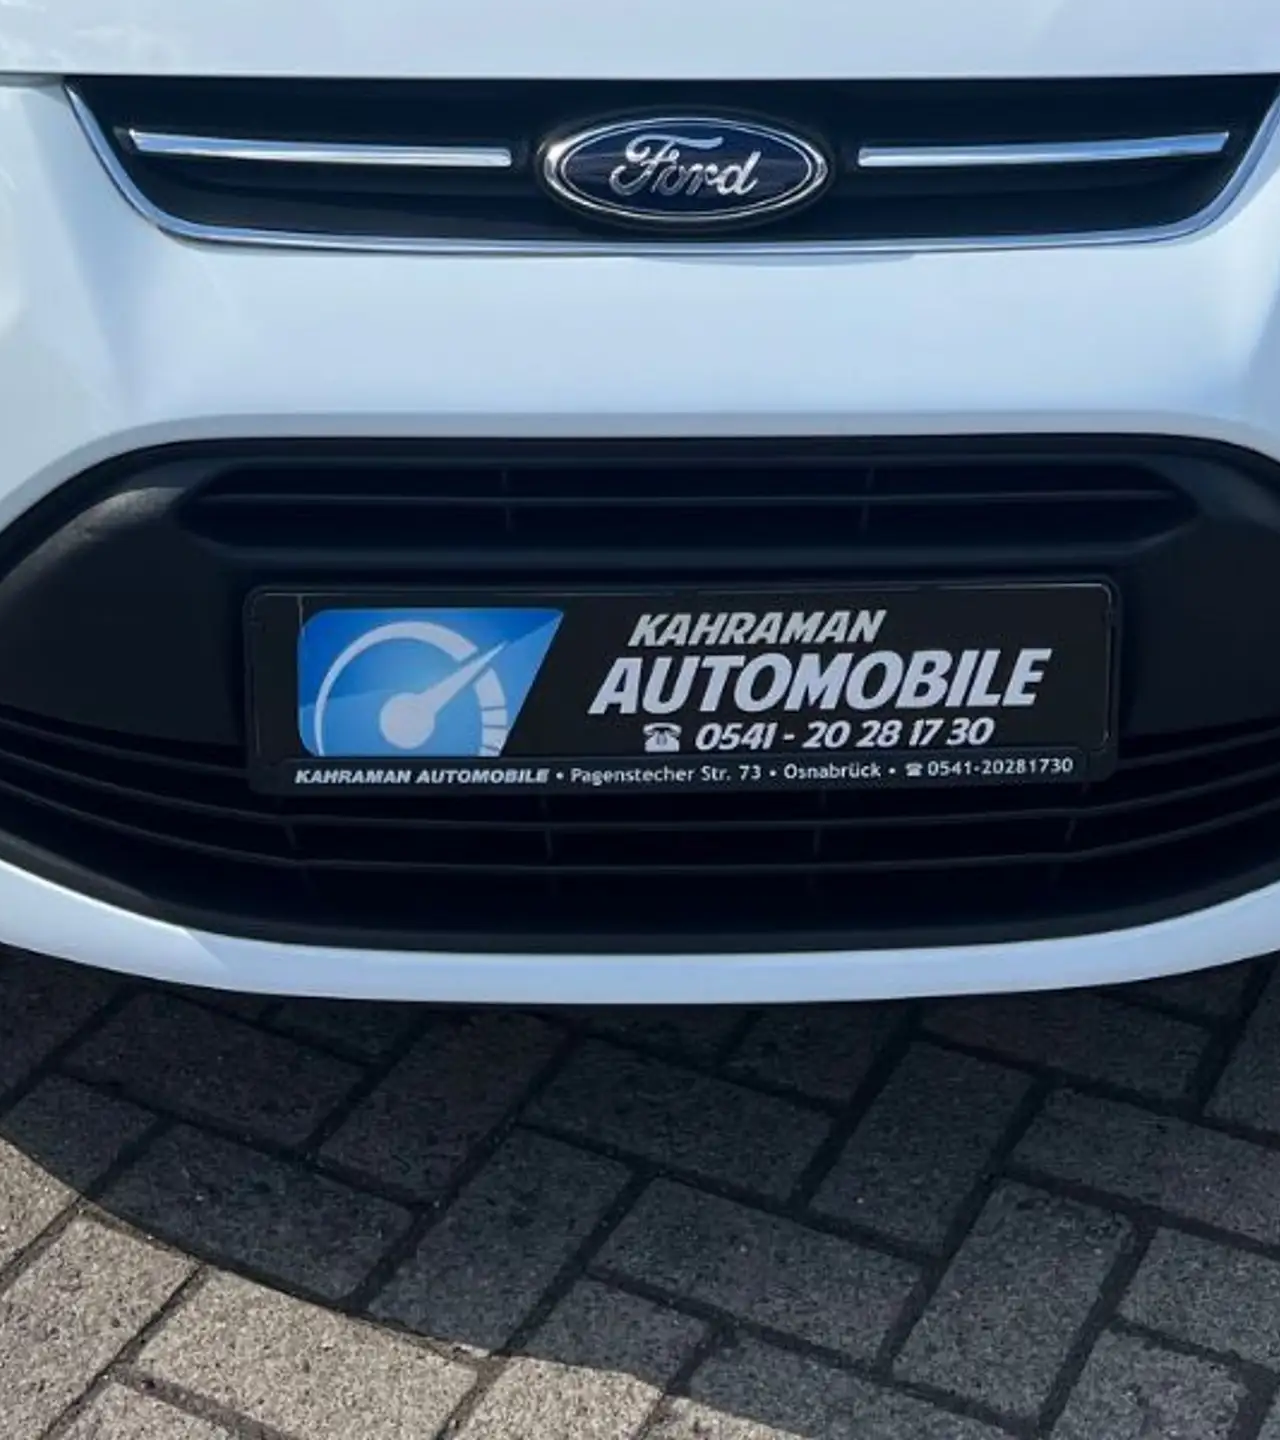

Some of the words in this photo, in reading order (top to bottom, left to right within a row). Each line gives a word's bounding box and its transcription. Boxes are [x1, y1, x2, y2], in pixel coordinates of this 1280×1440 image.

[608, 133, 762, 196] Ford
[628, 609, 887, 647] KAHRAMAN
[587, 647, 1053, 715] AUTOMOBILE
[694, 721, 779, 751] 0541
[801, 719, 851, 749] 20
[855, 719, 904, 748] 28
[908, 718, 944, 747] 17
[945, 716, 996, 746] 30
[294, 768, 412, 785] KAHRAMAN
[415, 767, 551, 784] AUTOMOBILE
[570, 766, 694, 785] Pagenstecher
[701, 764, 732, 782] Str.
[738, 764, 762, 781] 73
[782, 760, 882, 780] Osnabrück
[926, 757, 1074, 778] 0541-20281730
